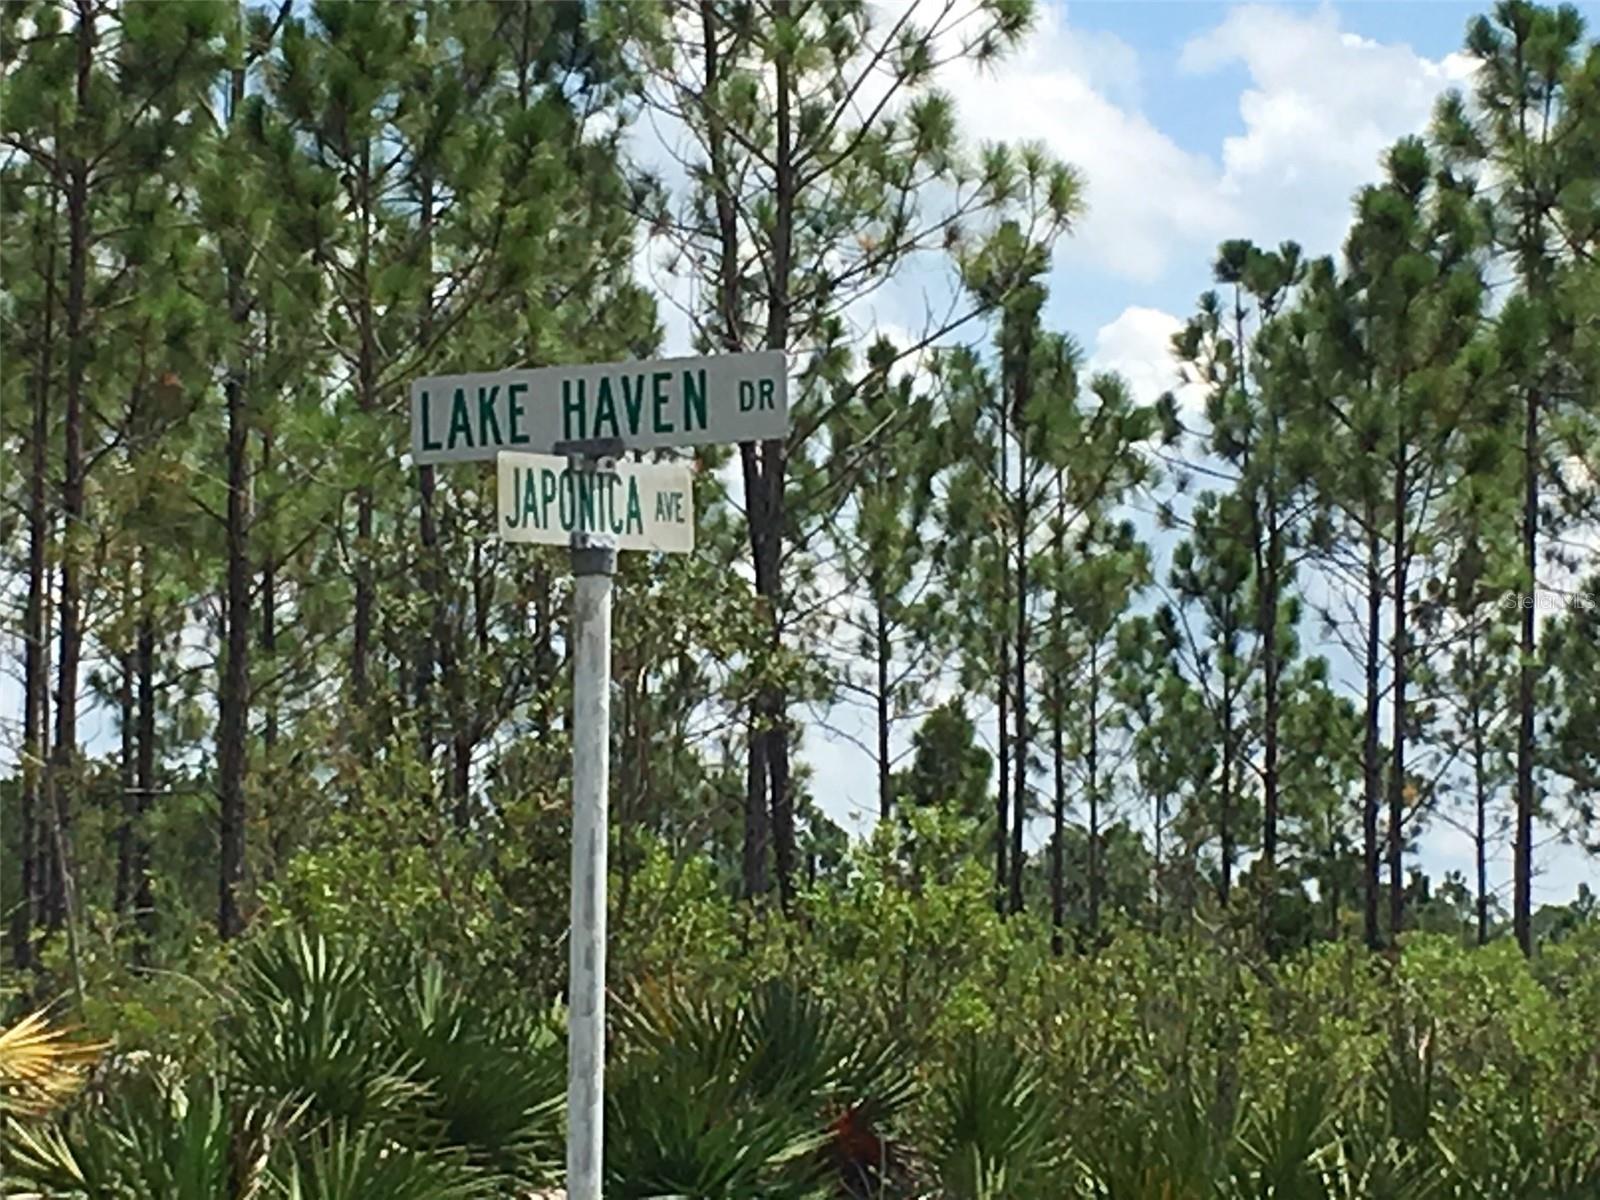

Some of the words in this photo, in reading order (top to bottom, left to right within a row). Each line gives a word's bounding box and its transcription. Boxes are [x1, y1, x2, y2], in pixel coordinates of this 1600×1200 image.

[421, 383, 530, 451] LAKE
[562, 369, 708, 440] HAVEN
[739, 379, 775, 412] DR
[505, 466, 644, 535] JAPONICA
[655, 491, 686, 524] AVE
